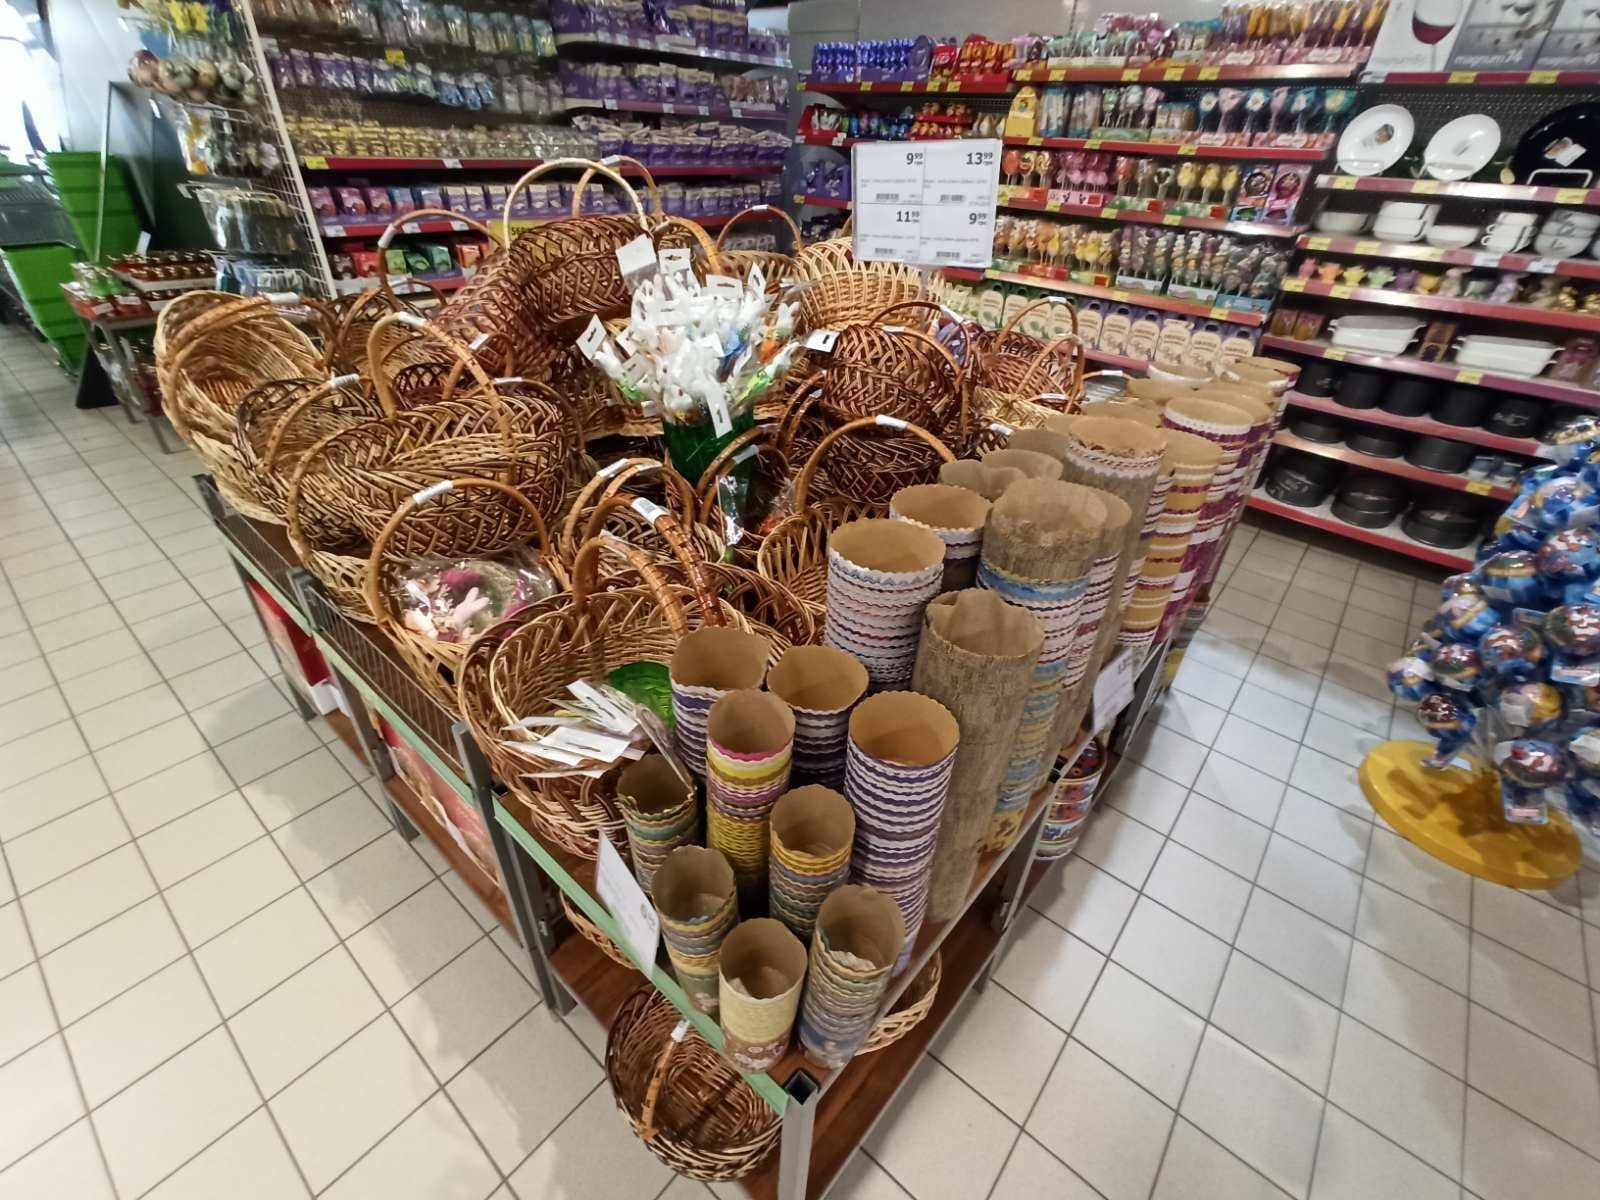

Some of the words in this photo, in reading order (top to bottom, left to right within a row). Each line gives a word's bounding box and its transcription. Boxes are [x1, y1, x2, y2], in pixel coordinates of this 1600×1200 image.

[906, 152, 914, 165] 9
[966, 152, 983, 165] 13
[896, 211, 911, 223] 11
[969, 212, 977, 225] 9
